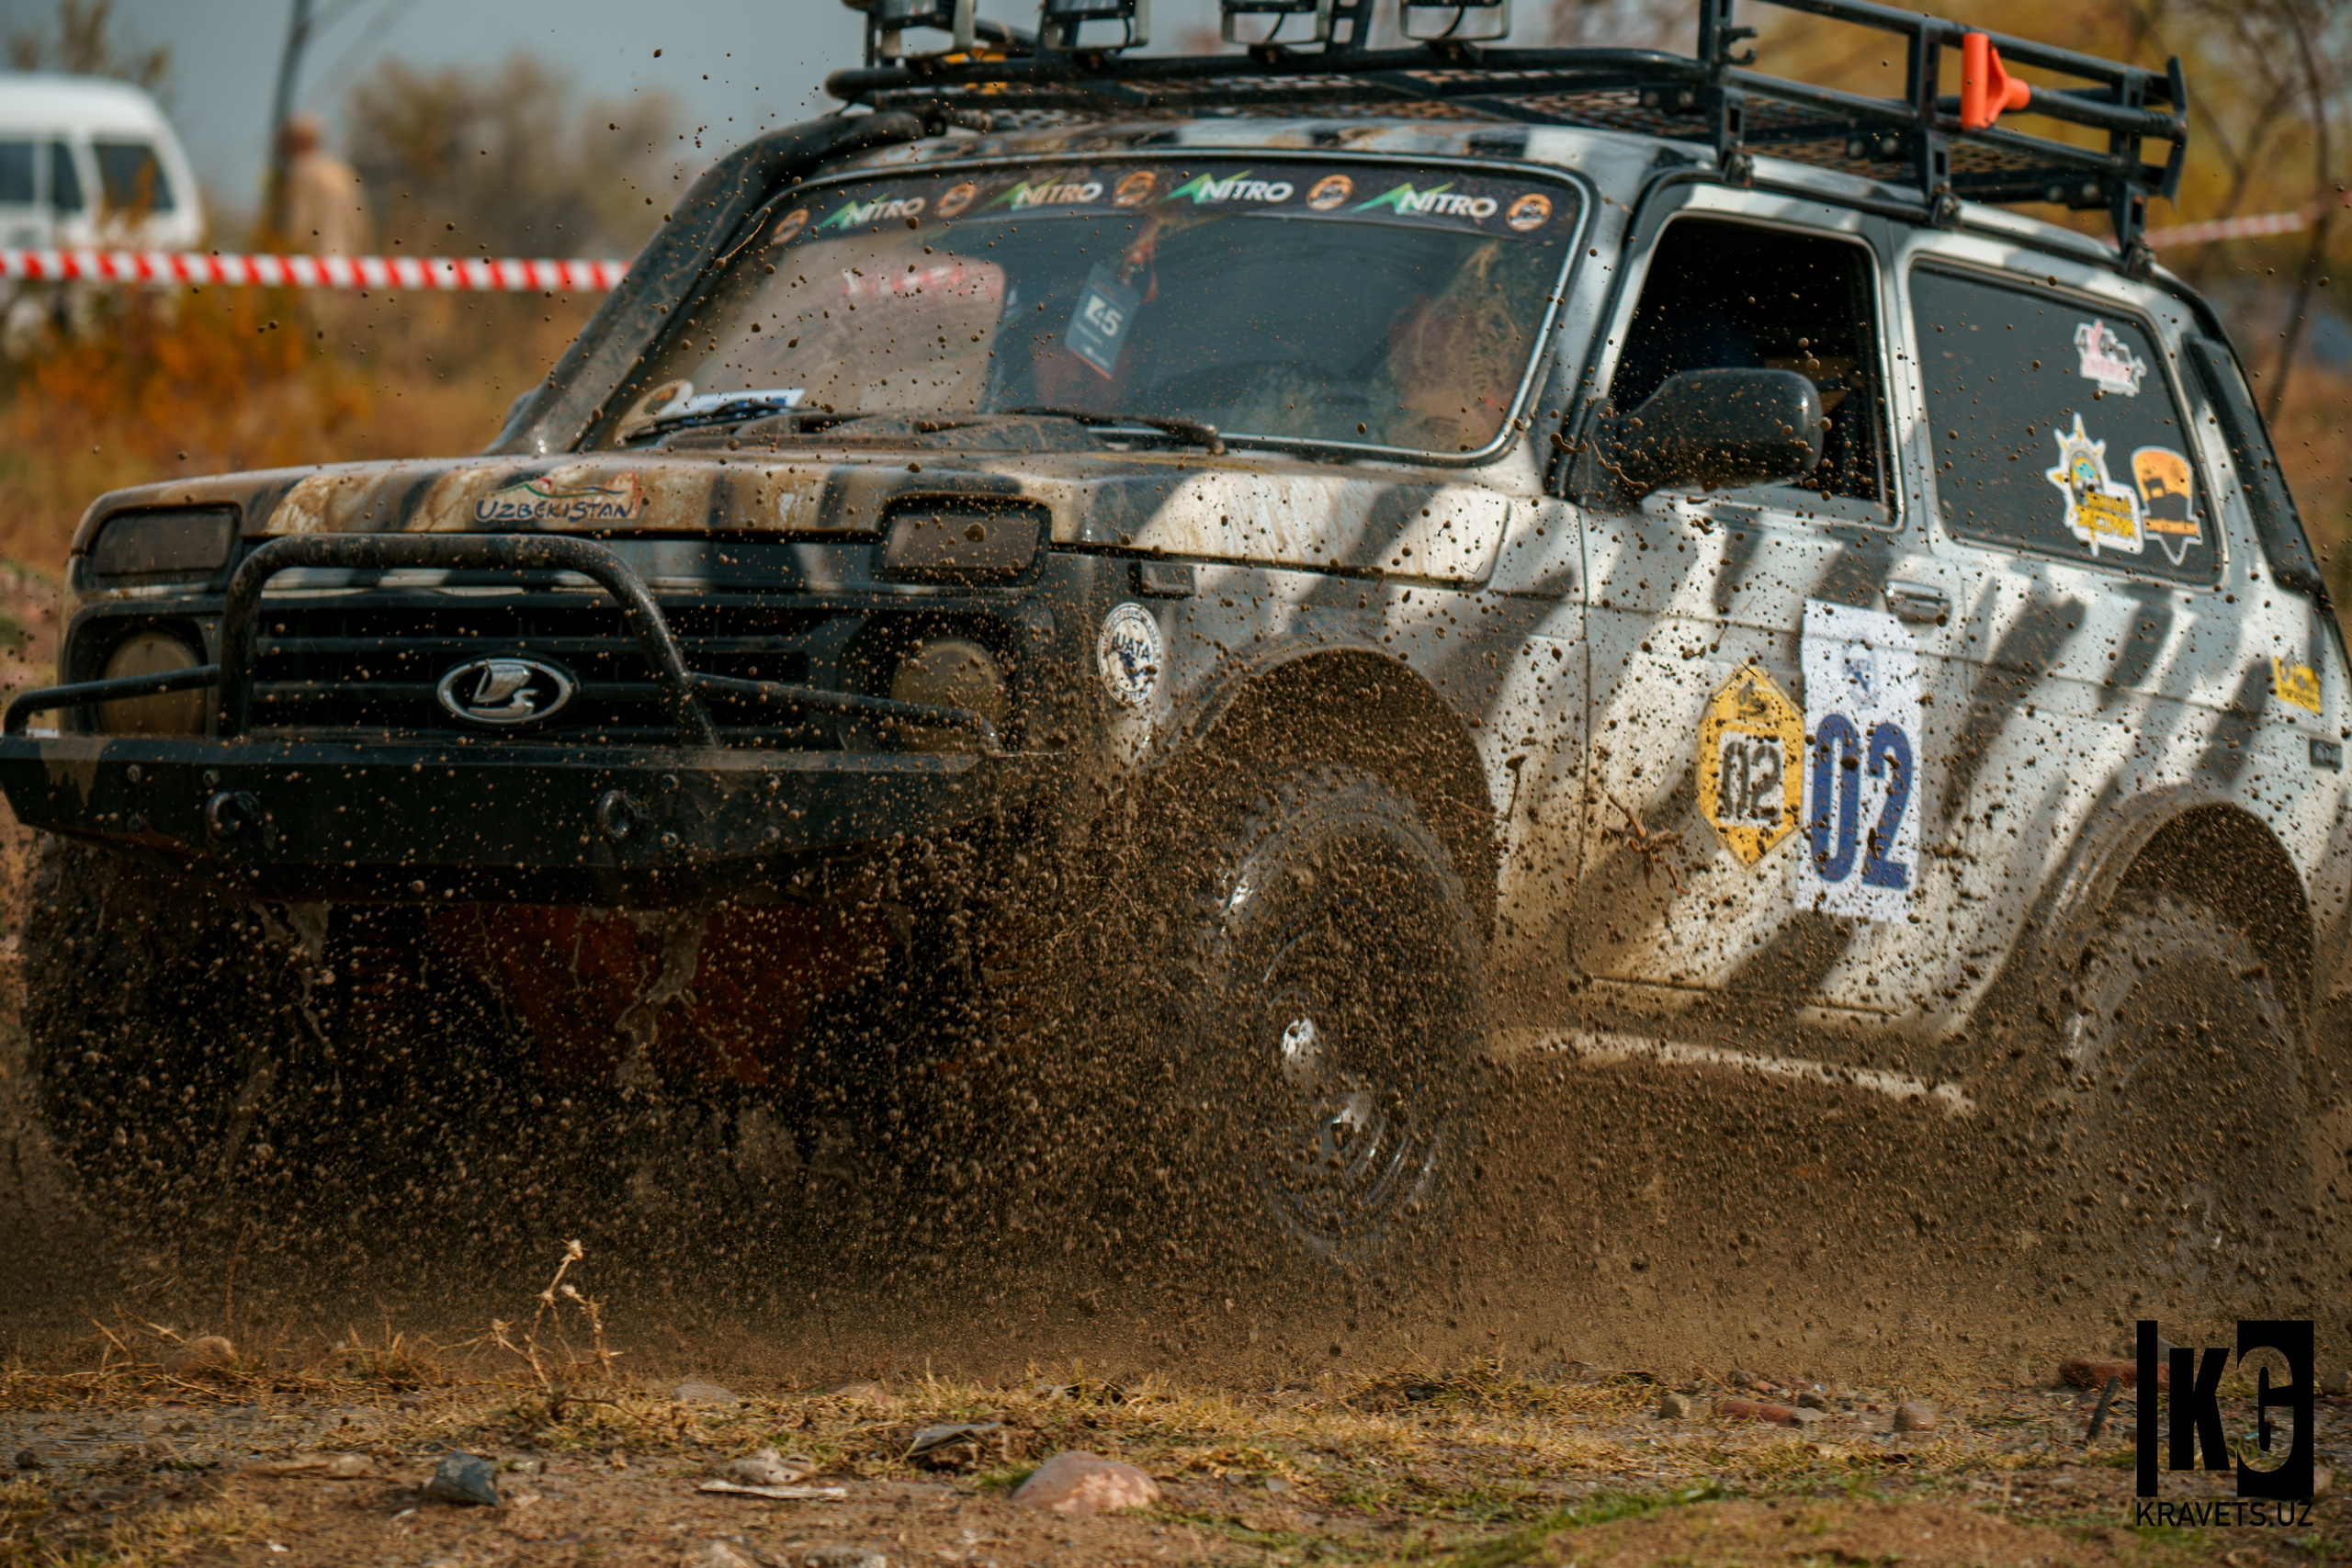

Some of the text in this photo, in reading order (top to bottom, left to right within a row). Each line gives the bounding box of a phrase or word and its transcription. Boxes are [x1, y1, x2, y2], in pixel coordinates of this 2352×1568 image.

[1011, 182, 1103, 210] NITRO
[1194, 178, 1295, 205] NITRO
[1396, 187, 1498, 219] NITRO
[839, 196, 927, 231] NITRO
[476, 500, 634, 523] UZBEKISTAN
[1721, 740, 1782, 822] 02
[1811, 713, 1913, 890] 02
